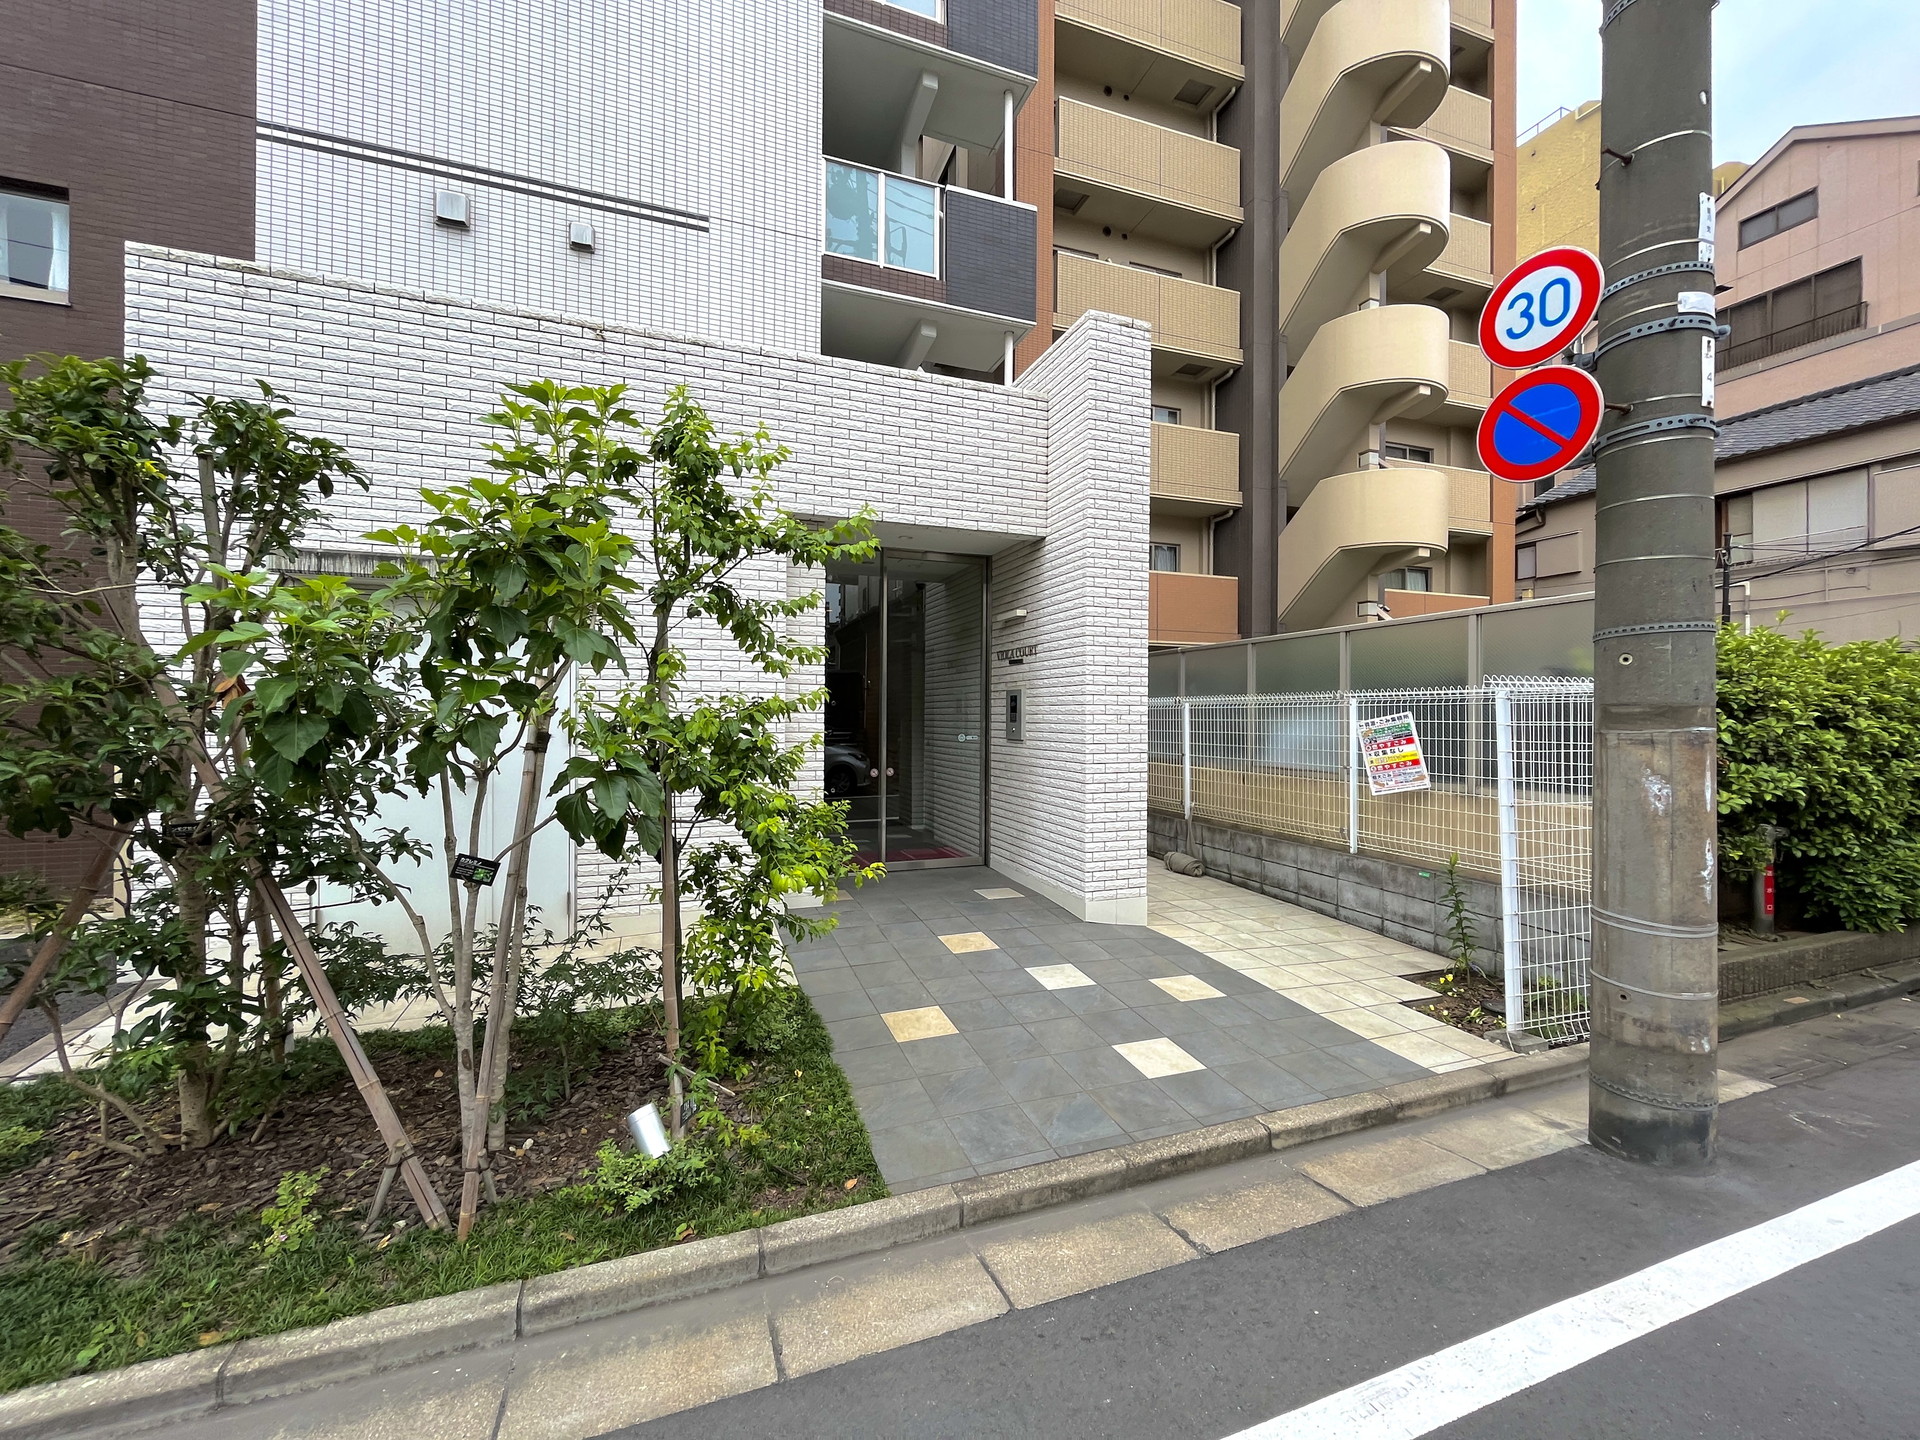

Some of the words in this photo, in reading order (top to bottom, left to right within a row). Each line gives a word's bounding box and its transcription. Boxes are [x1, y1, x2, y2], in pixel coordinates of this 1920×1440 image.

[1505, 277, 1571, 340] 30
[1016, 645, 1038, 657] COURT
[1374, 748, 1404, 757] 収集なし
